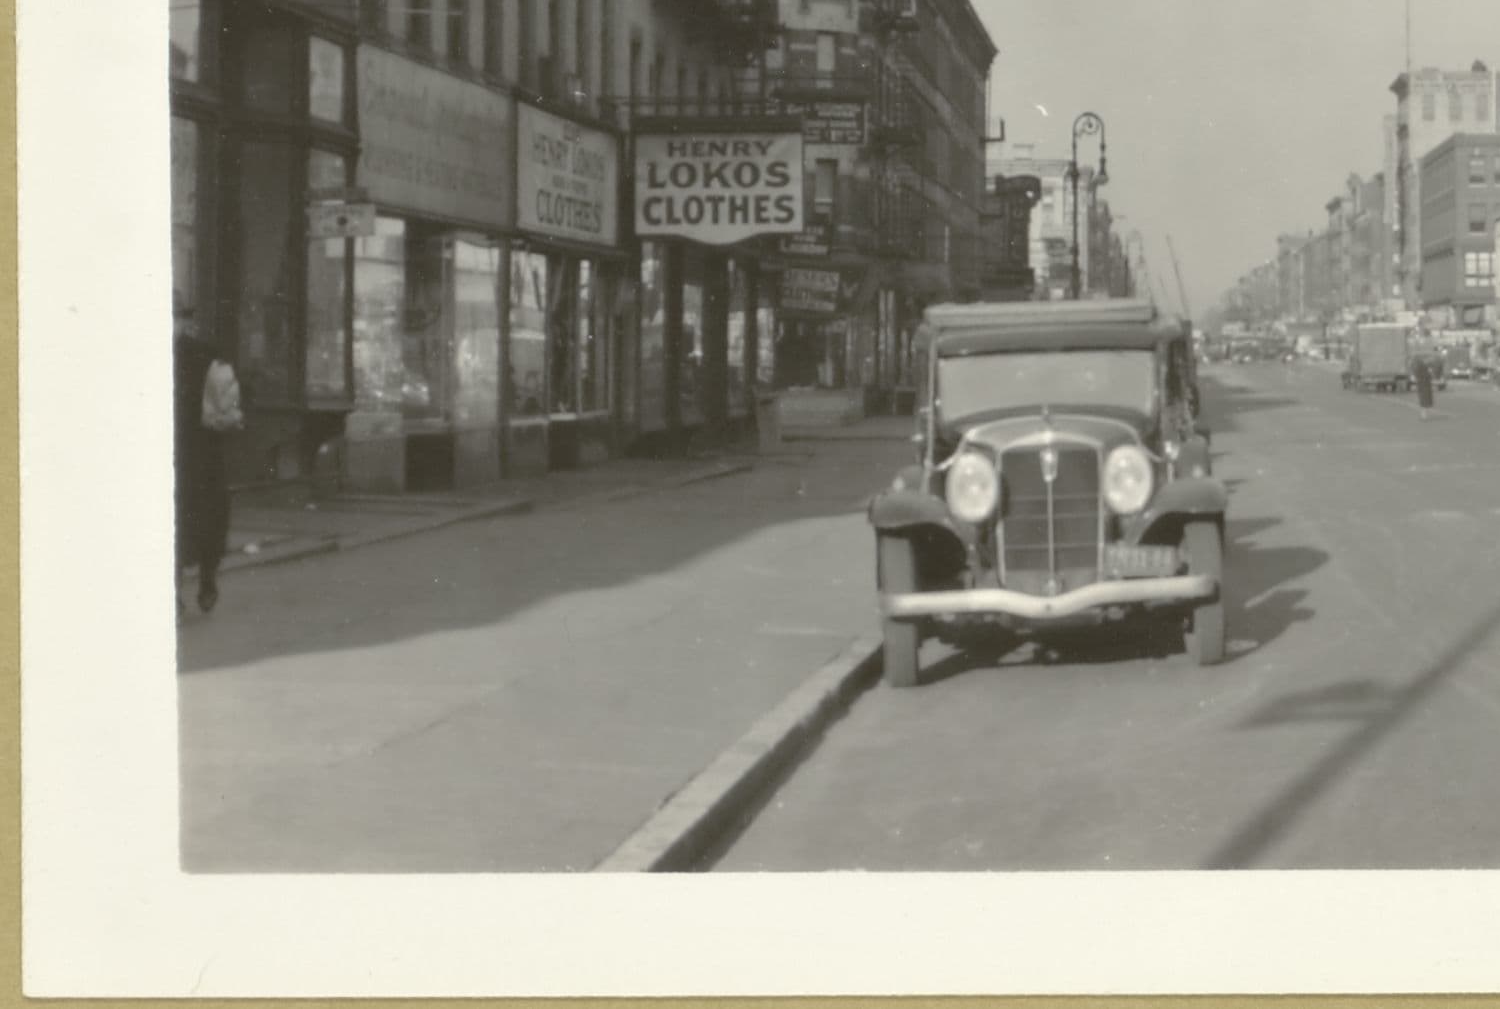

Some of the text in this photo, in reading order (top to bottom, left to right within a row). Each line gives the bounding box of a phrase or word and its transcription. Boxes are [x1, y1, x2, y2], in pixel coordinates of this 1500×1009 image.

[667, 140, 774, 158] HENRY
[647, 161, 792, 189] LOKOS
[535, 188, 604, 235] CLOTHES
[642, 194, 796, 226] CLOTHES
